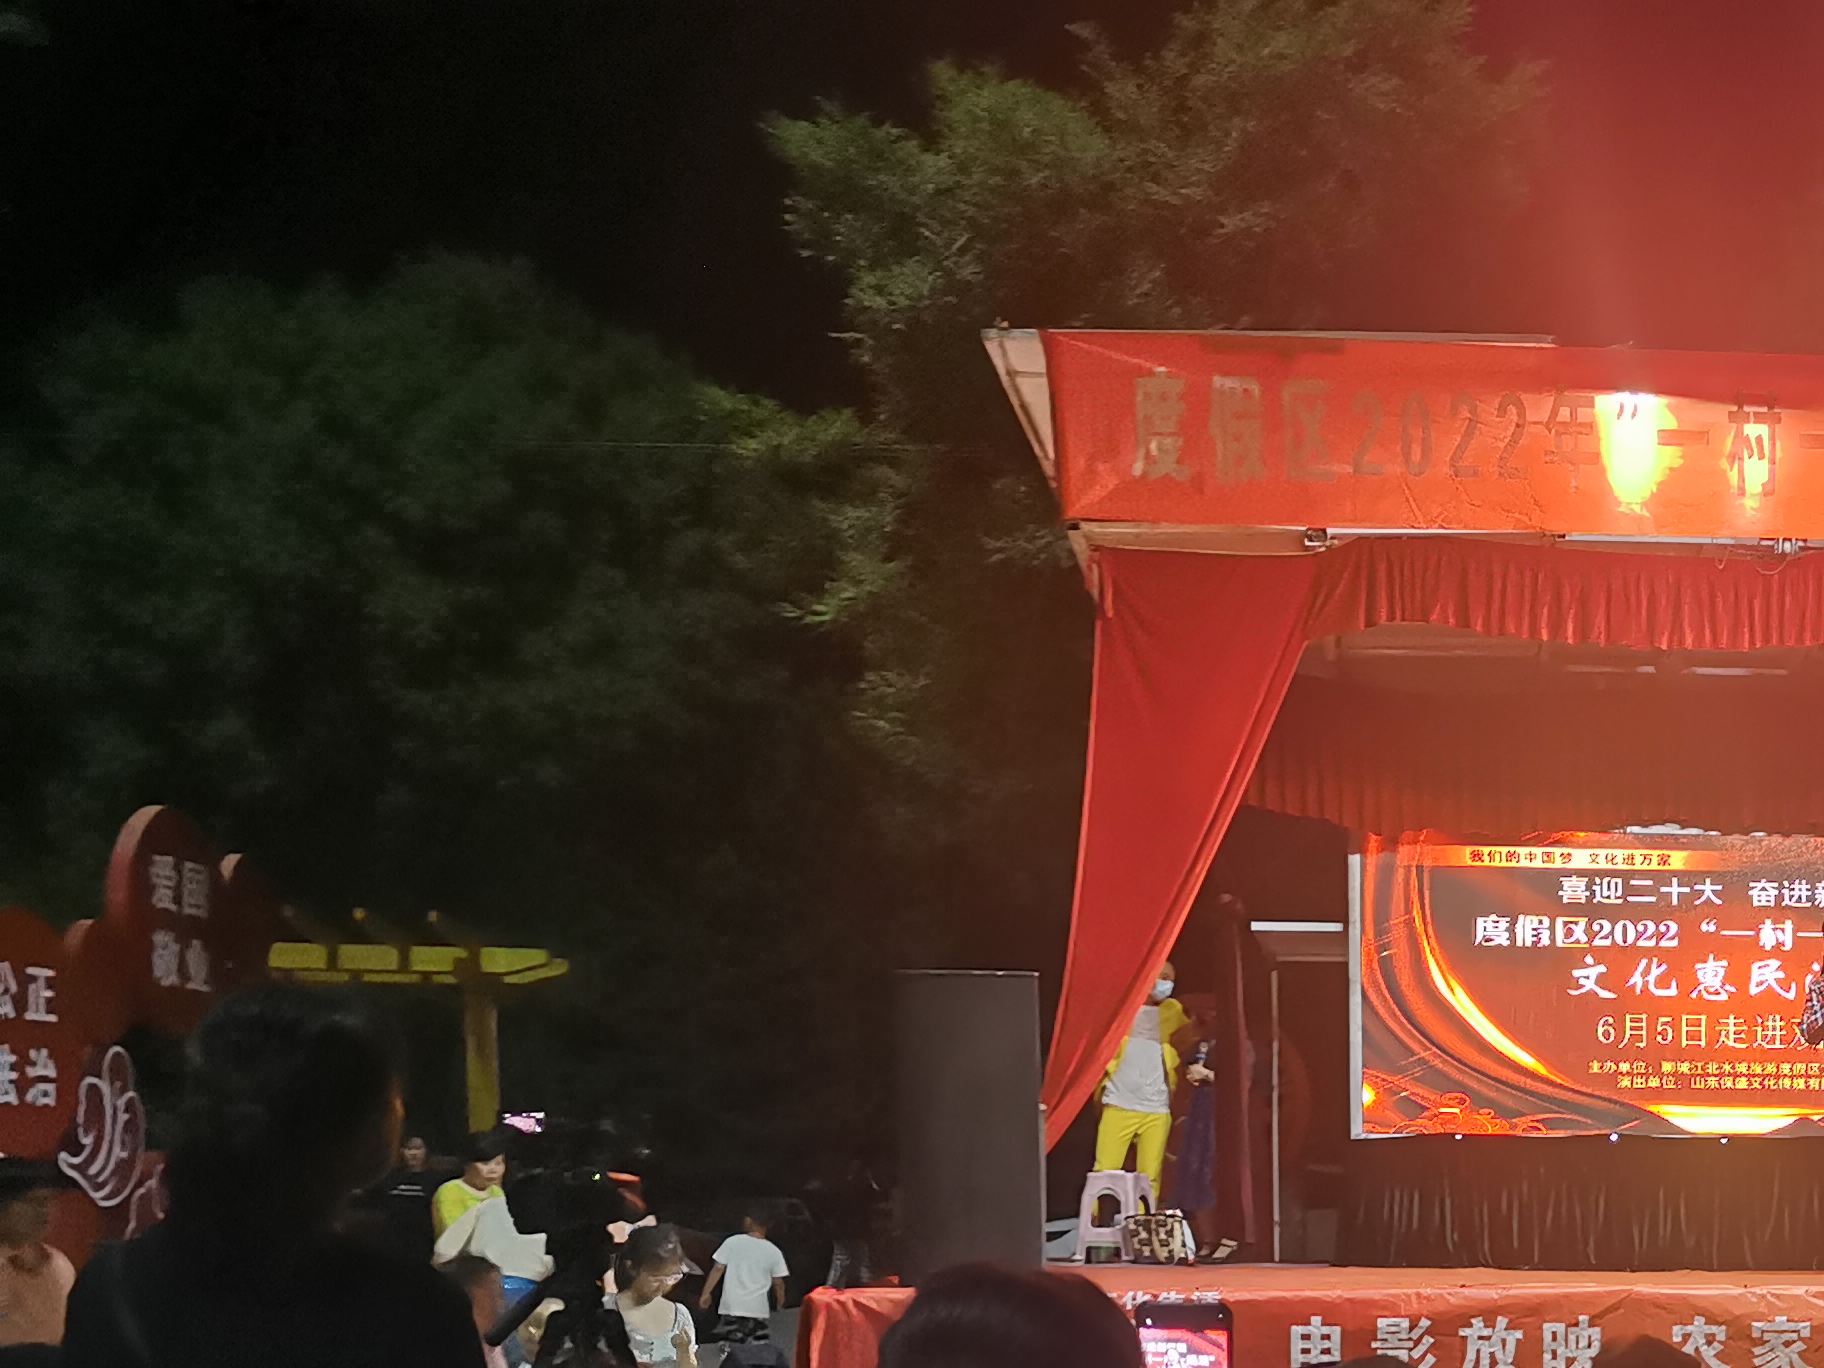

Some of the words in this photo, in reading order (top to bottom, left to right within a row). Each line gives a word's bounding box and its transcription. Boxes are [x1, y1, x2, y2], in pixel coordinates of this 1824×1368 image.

[1468, 849, 1574, 864] 我们的中国梦
[1589, 851, 1673, 867] 文化进万家
[1557, 875, 1723, 906] 喜迎二十大
